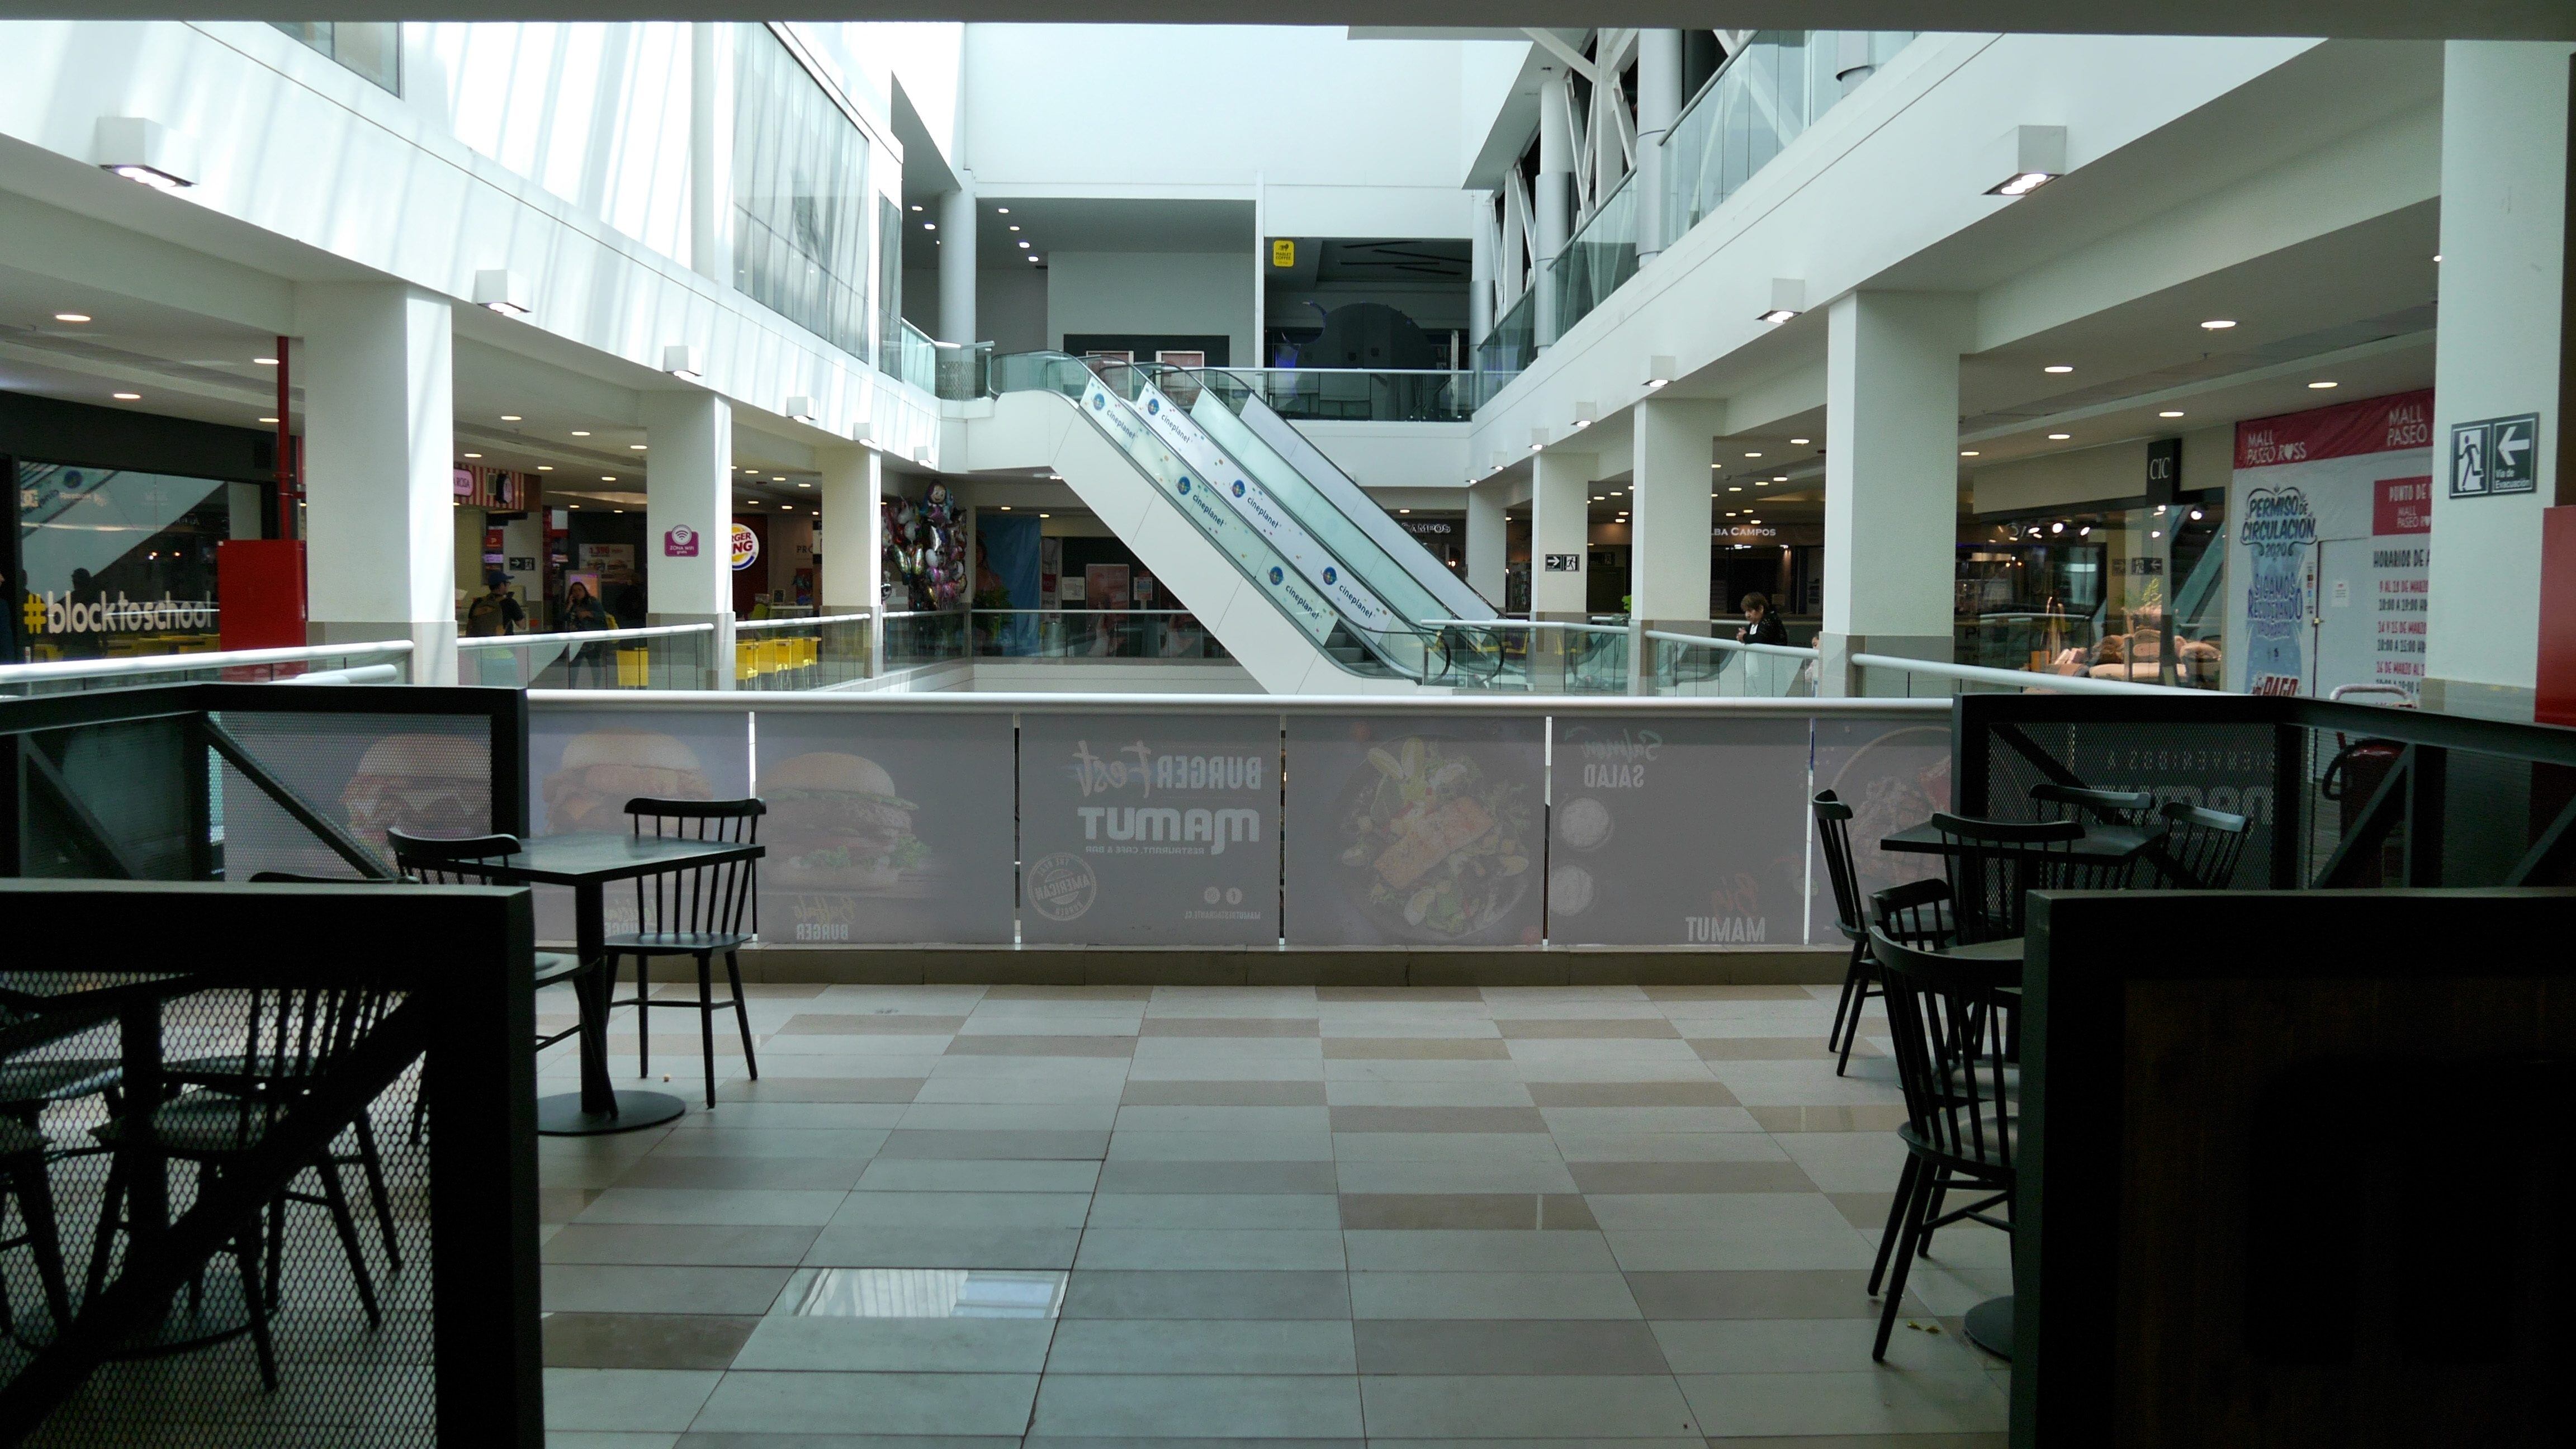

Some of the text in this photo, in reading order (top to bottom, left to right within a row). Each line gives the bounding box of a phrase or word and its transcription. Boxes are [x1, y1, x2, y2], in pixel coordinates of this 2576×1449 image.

[1107, 409, 1137, 440] cineplanet
[2388, 404, 2423, 425] MALL
[1161, 413, 1191, 443] cineplanet
[2248, 430, 2275, 447] MALL
[2387, 423, 2428, 447] PASEO
[2247, 447, 2276, 465] PASEO
[2150, 457, 2170, 480] CIC
[2389, 485, 2413, 501] PUNTO
[2416, 484, 2427, 500] DE
[1193, 494, 1225, 528] cineplanet
[1247, 496, 1280, 529] cineplanet
[2250, 495, 2299, 518] PERMISO
[1730, 527, 1777, 536] CAMPOS
[2373, 550, 2411, 567] HORARIOS
[2414, 548, 2424, 567] DE
[2401, 580, 2409, 593] DE
[1286, 585, 1320, 619] cineplanet
[1339, 584, 1374, 618] cineplanet
[2396, 598, 2400, 612] A
[23, 590, 212, 634] #blocktoschool
[2399, 621, 2407, 634] DE
[2395, 639, 2399, 652] A
[2385, 661, 2392, 674] DE
